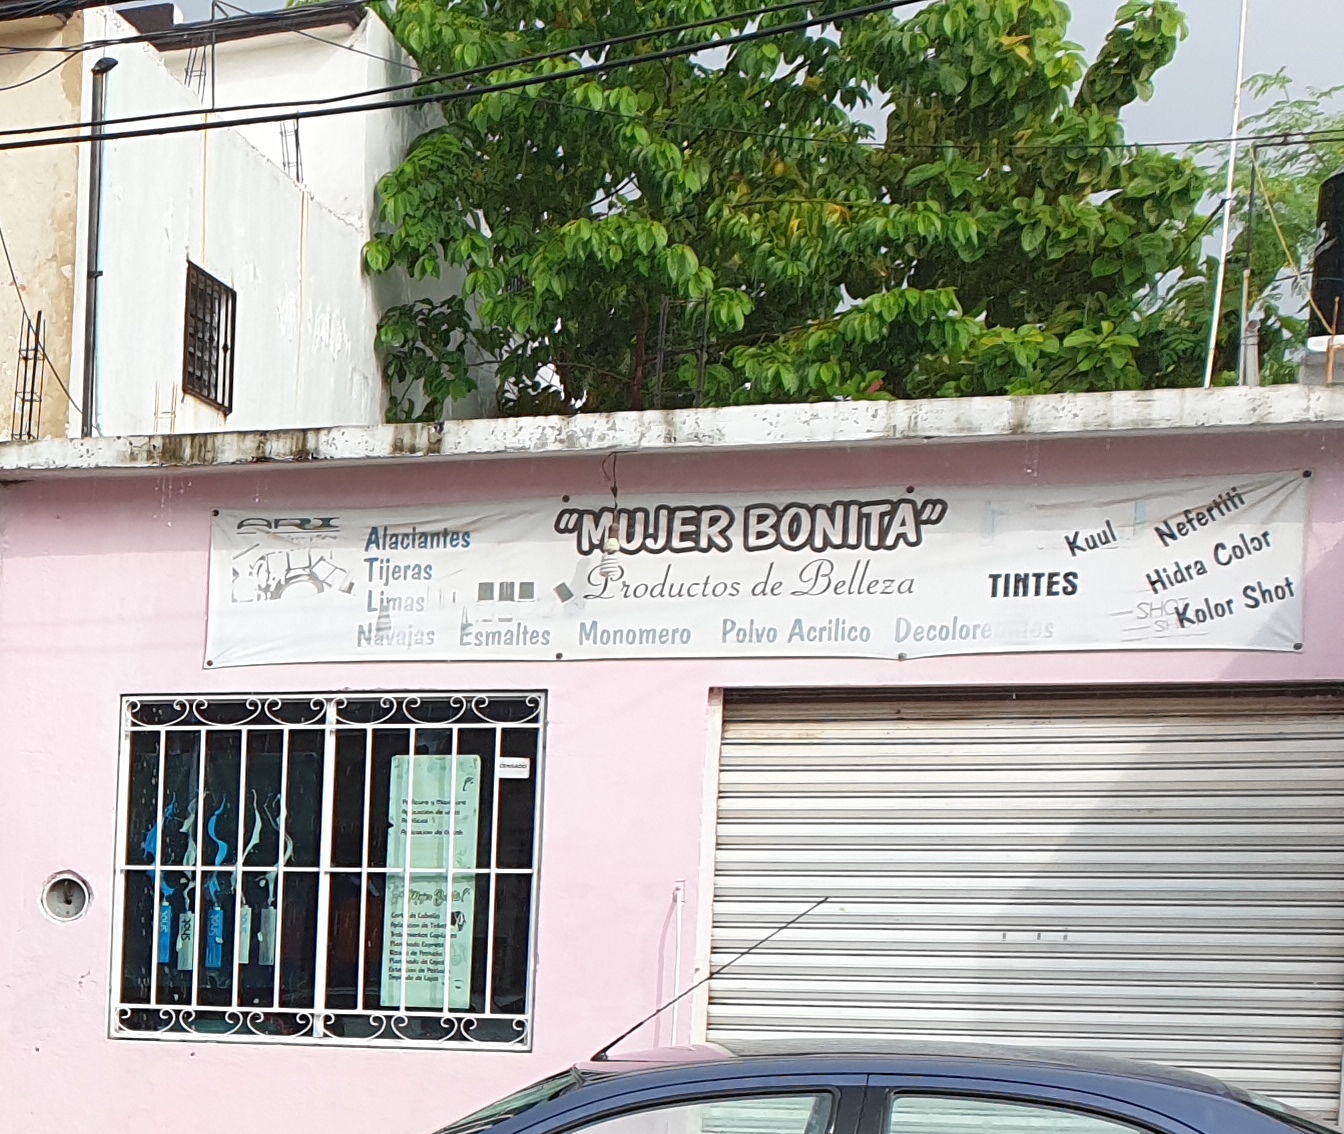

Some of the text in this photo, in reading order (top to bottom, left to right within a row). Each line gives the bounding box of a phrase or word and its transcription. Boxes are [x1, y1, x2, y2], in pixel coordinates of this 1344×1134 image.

[744, 499, 948, 551] BONITA"
[1153, 487, 1246, 547] Nefertiti
[365, 526, 471, 552] Alaciantes
[1064, 520, 1118, 557] Kuul
[364, 557, 433, 586] Tijeras
[582, 558, 915, 601] Productos de Belleza
[1145, 530, 1272, 594] Hidra Color
[367, 590, 425, 612] Limas
[989, 572, 1078, 597] TINTES
[1174, 576, 1295, 628] Kolor Shot
[357, 624, 435, 649] Navajas
[459, 622, 551, 646] Esmaltes
[579, 619, 692, 645] Monomero
[722, 618, 778, 643] Polvo
[787, 615, 871, 643] Acrilico
